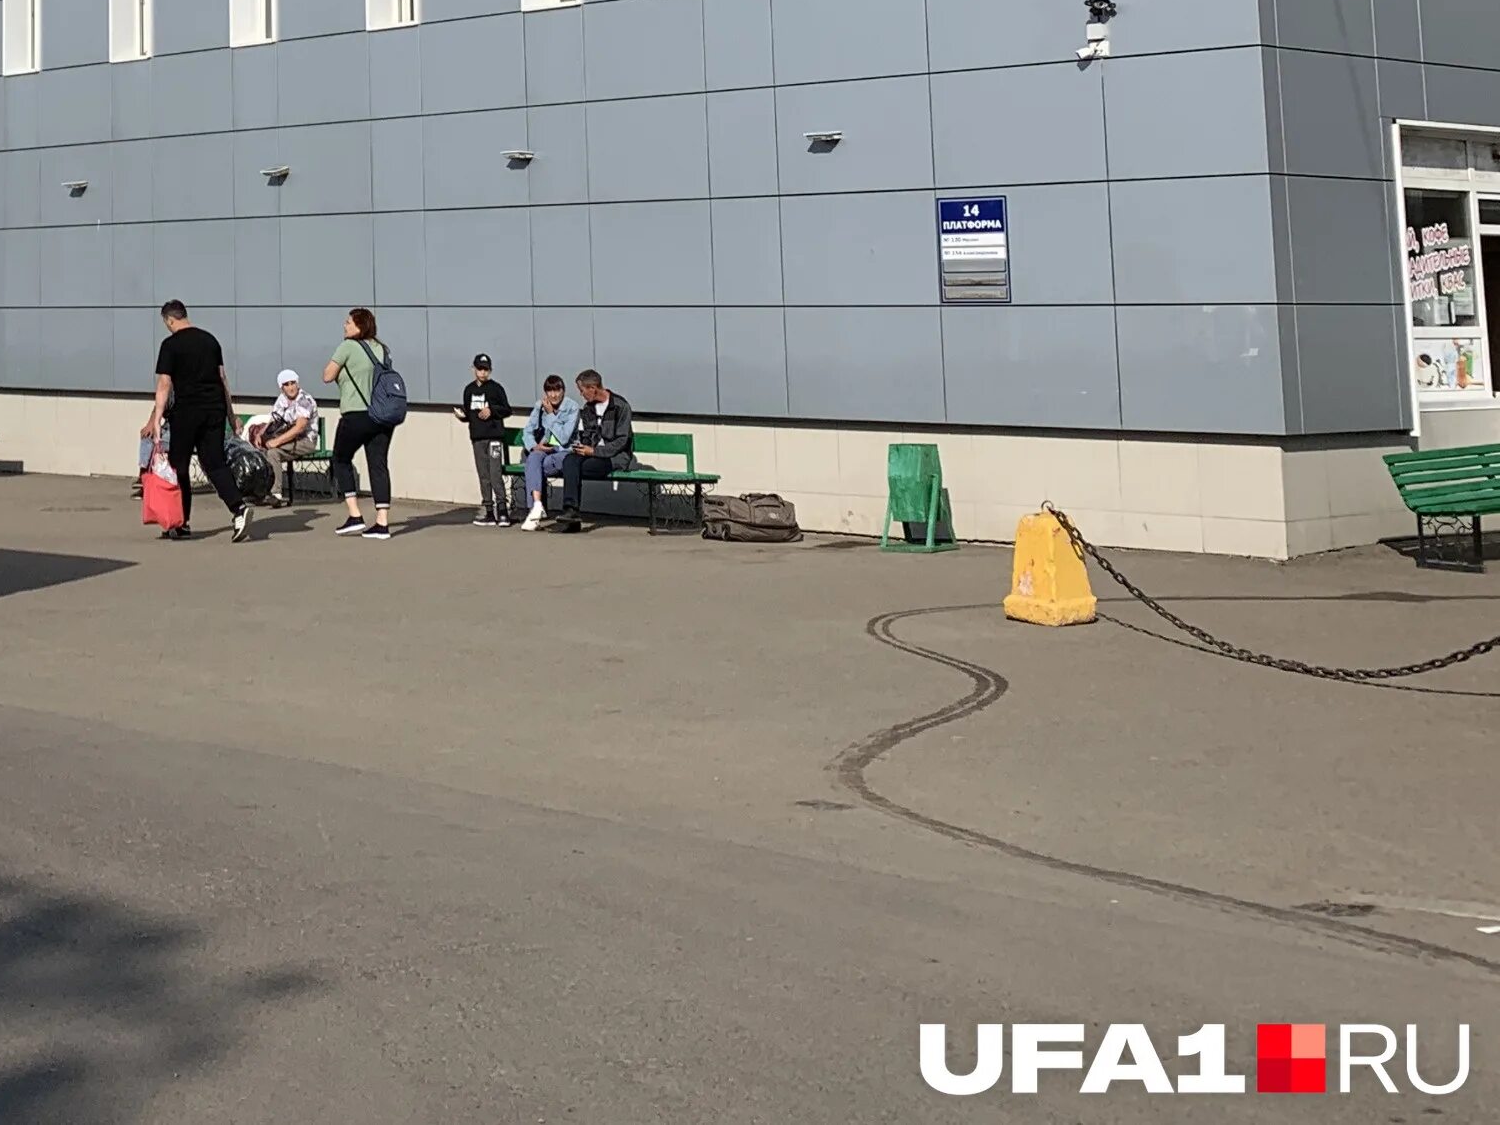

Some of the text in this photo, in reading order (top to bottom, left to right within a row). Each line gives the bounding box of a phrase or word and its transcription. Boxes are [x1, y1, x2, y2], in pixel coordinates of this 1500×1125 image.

[963, 204, 980, 217] 14
[942, 219, 1003, 230] ПЛАТФОРМА
[1421, 223, 1450, 247] КОФЕ
[1440, 269, 1467, 295] КВАС
